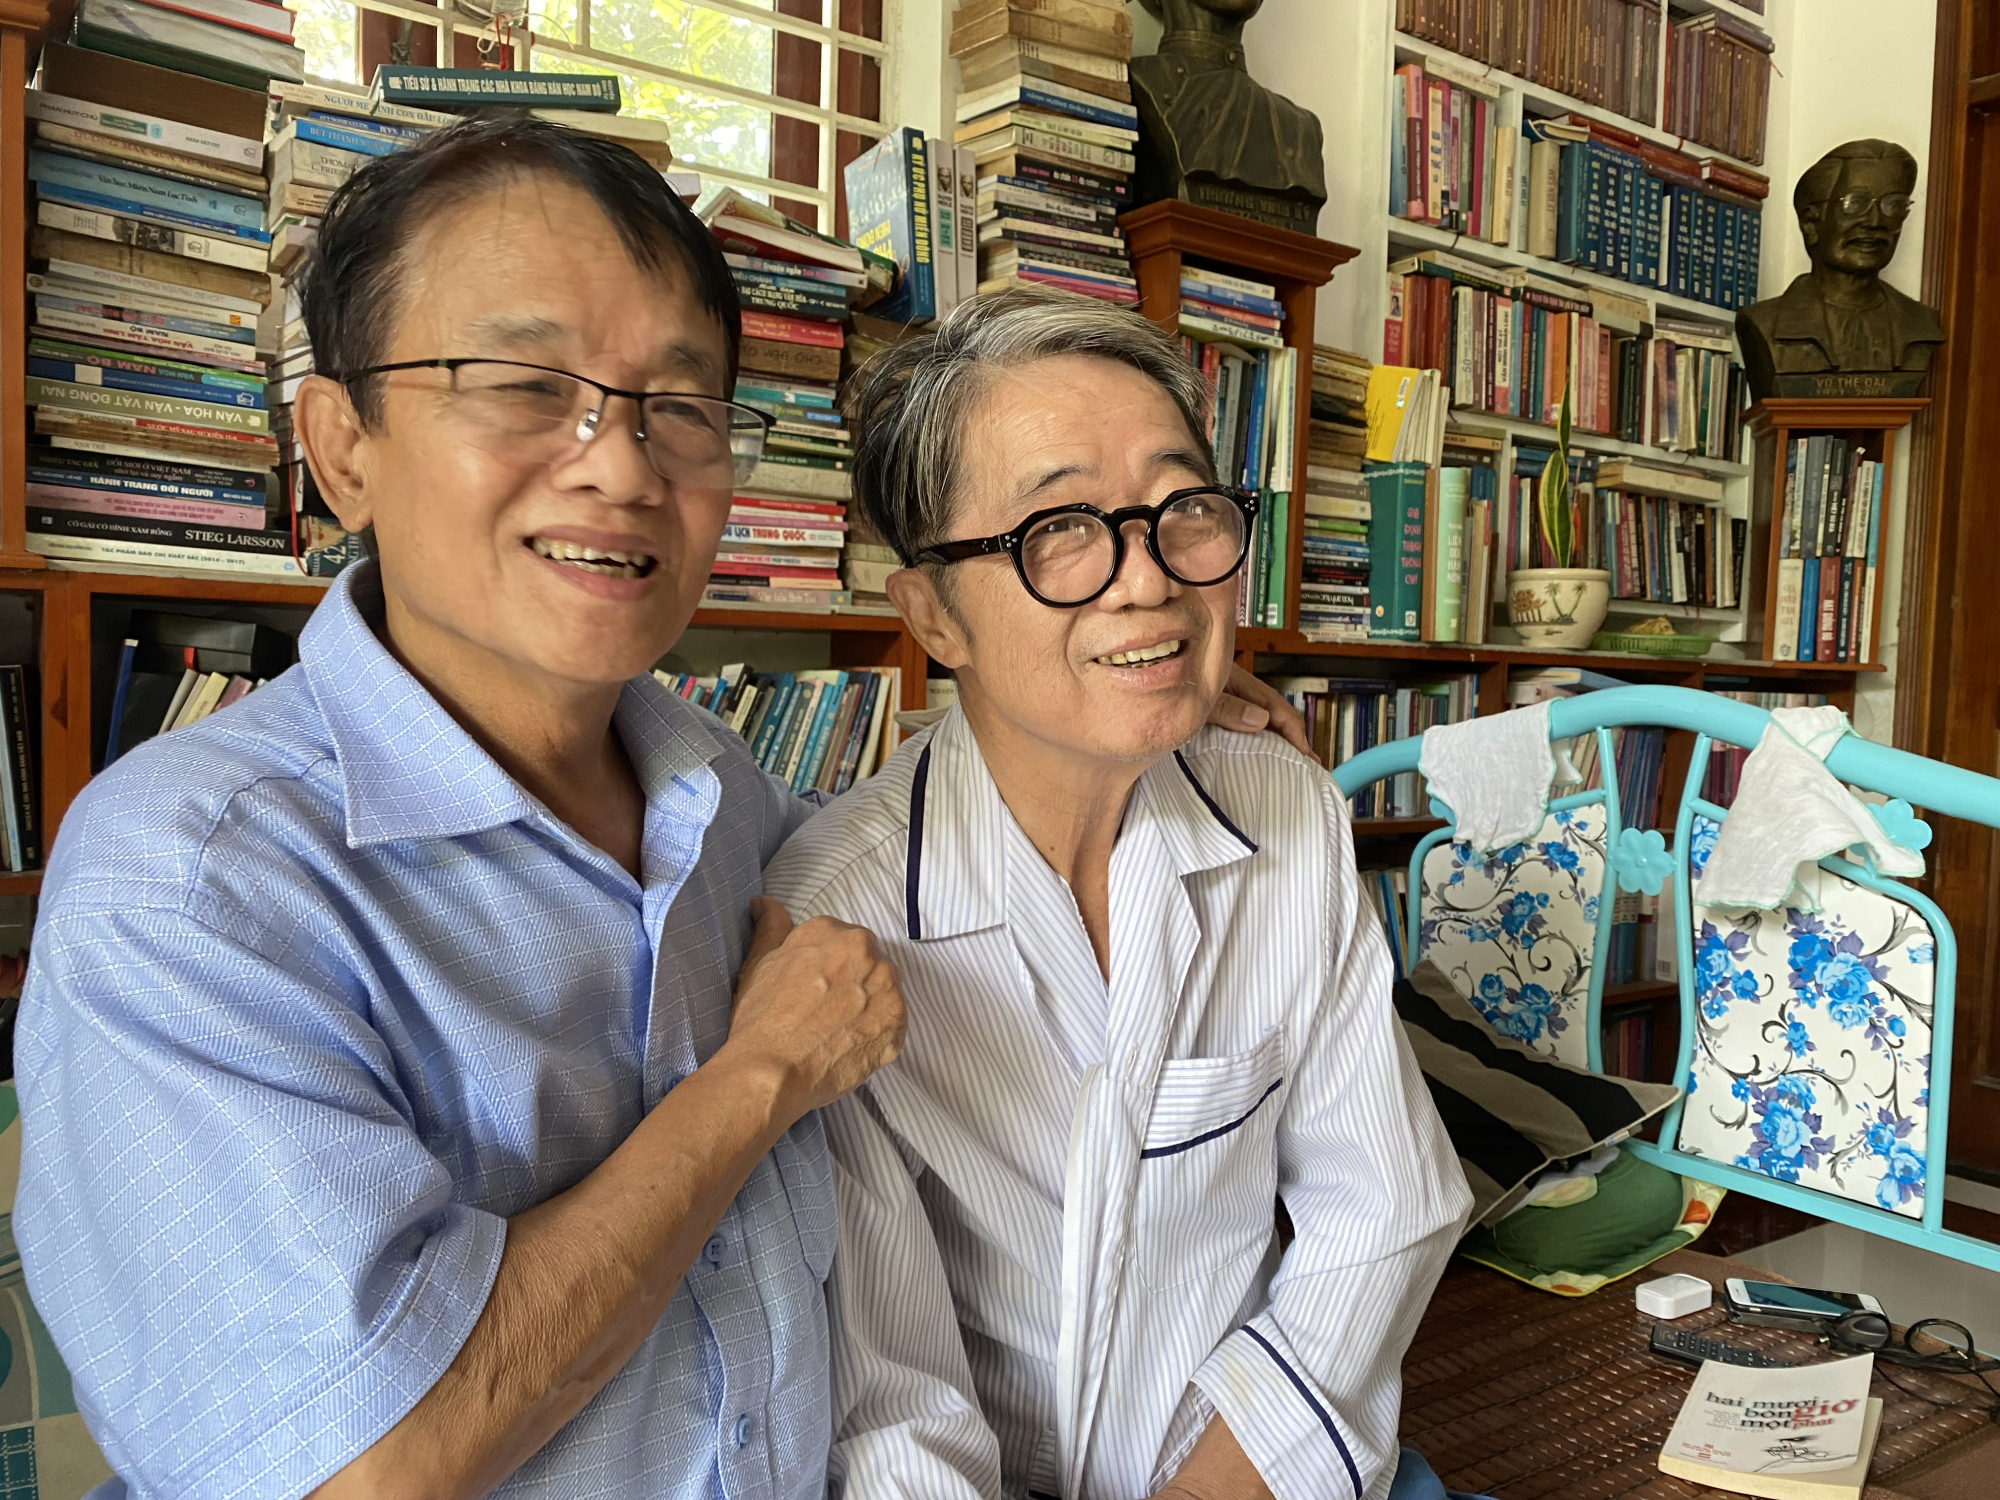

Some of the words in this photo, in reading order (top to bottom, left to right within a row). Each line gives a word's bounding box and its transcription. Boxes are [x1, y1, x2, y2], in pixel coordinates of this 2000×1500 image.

[403, 76, 418, 91] TIỂU
[431, 77, 438, 91] &
[438, 77, 457, 92] HÀNH
[457, 78, 480, 95] TRẠNG
[480, 78, 495, 93] CÁC
[510, 80, 528, 94] KHOA
[576, 83, 592, 96] NAM
[396, 108, 415, 119] CON
[328, 131, 358, 146] THANH
[912, 153, 925, 166] KÝ
[913, 167, 926, 181] ỨC
[912, 181, 927, 200] PHỤ
[914, 201, 928, 214] NỮ
[915, 214, 930, 237] MIỀN
[916, 238, 930, 264] ĐÔNG
[750, 296, 777, 308] TRUNG
[776, 299, 801, 312] QUỐC
[102, 326, 123, 337] LINH
[117, 358, 157, 375] NAM
[40, 384, 66, 398] NAI
[68, 387, 110, 405] ĐỒNG
[113, 391, 143, 411] VẬT
[143, 398, 173, 415] VĂN
[183, 403, 212, 420] HÓA
[215, 408, 242, 424] VĂN
[171, 467, 192, 478] NAM
[90, 476, 122, 487] HÀNH
[122, 480, 159, 492] TRANG
[160, 483, 179, 494] ĐỜI
[181, 486, 214, 499] NGƯỜI
[184, 528, 225, 543] STIEG
[226, 533, 286, 550] LARSSON
[733, 526, 750, 540] LỊCH
[752, 527, 780, 541] TRUNG
[782, 528, 806, 543] QUỐC
[1705, 1391, 1744, 1408] hai
[1740, 1418, 1791, 1431] một
